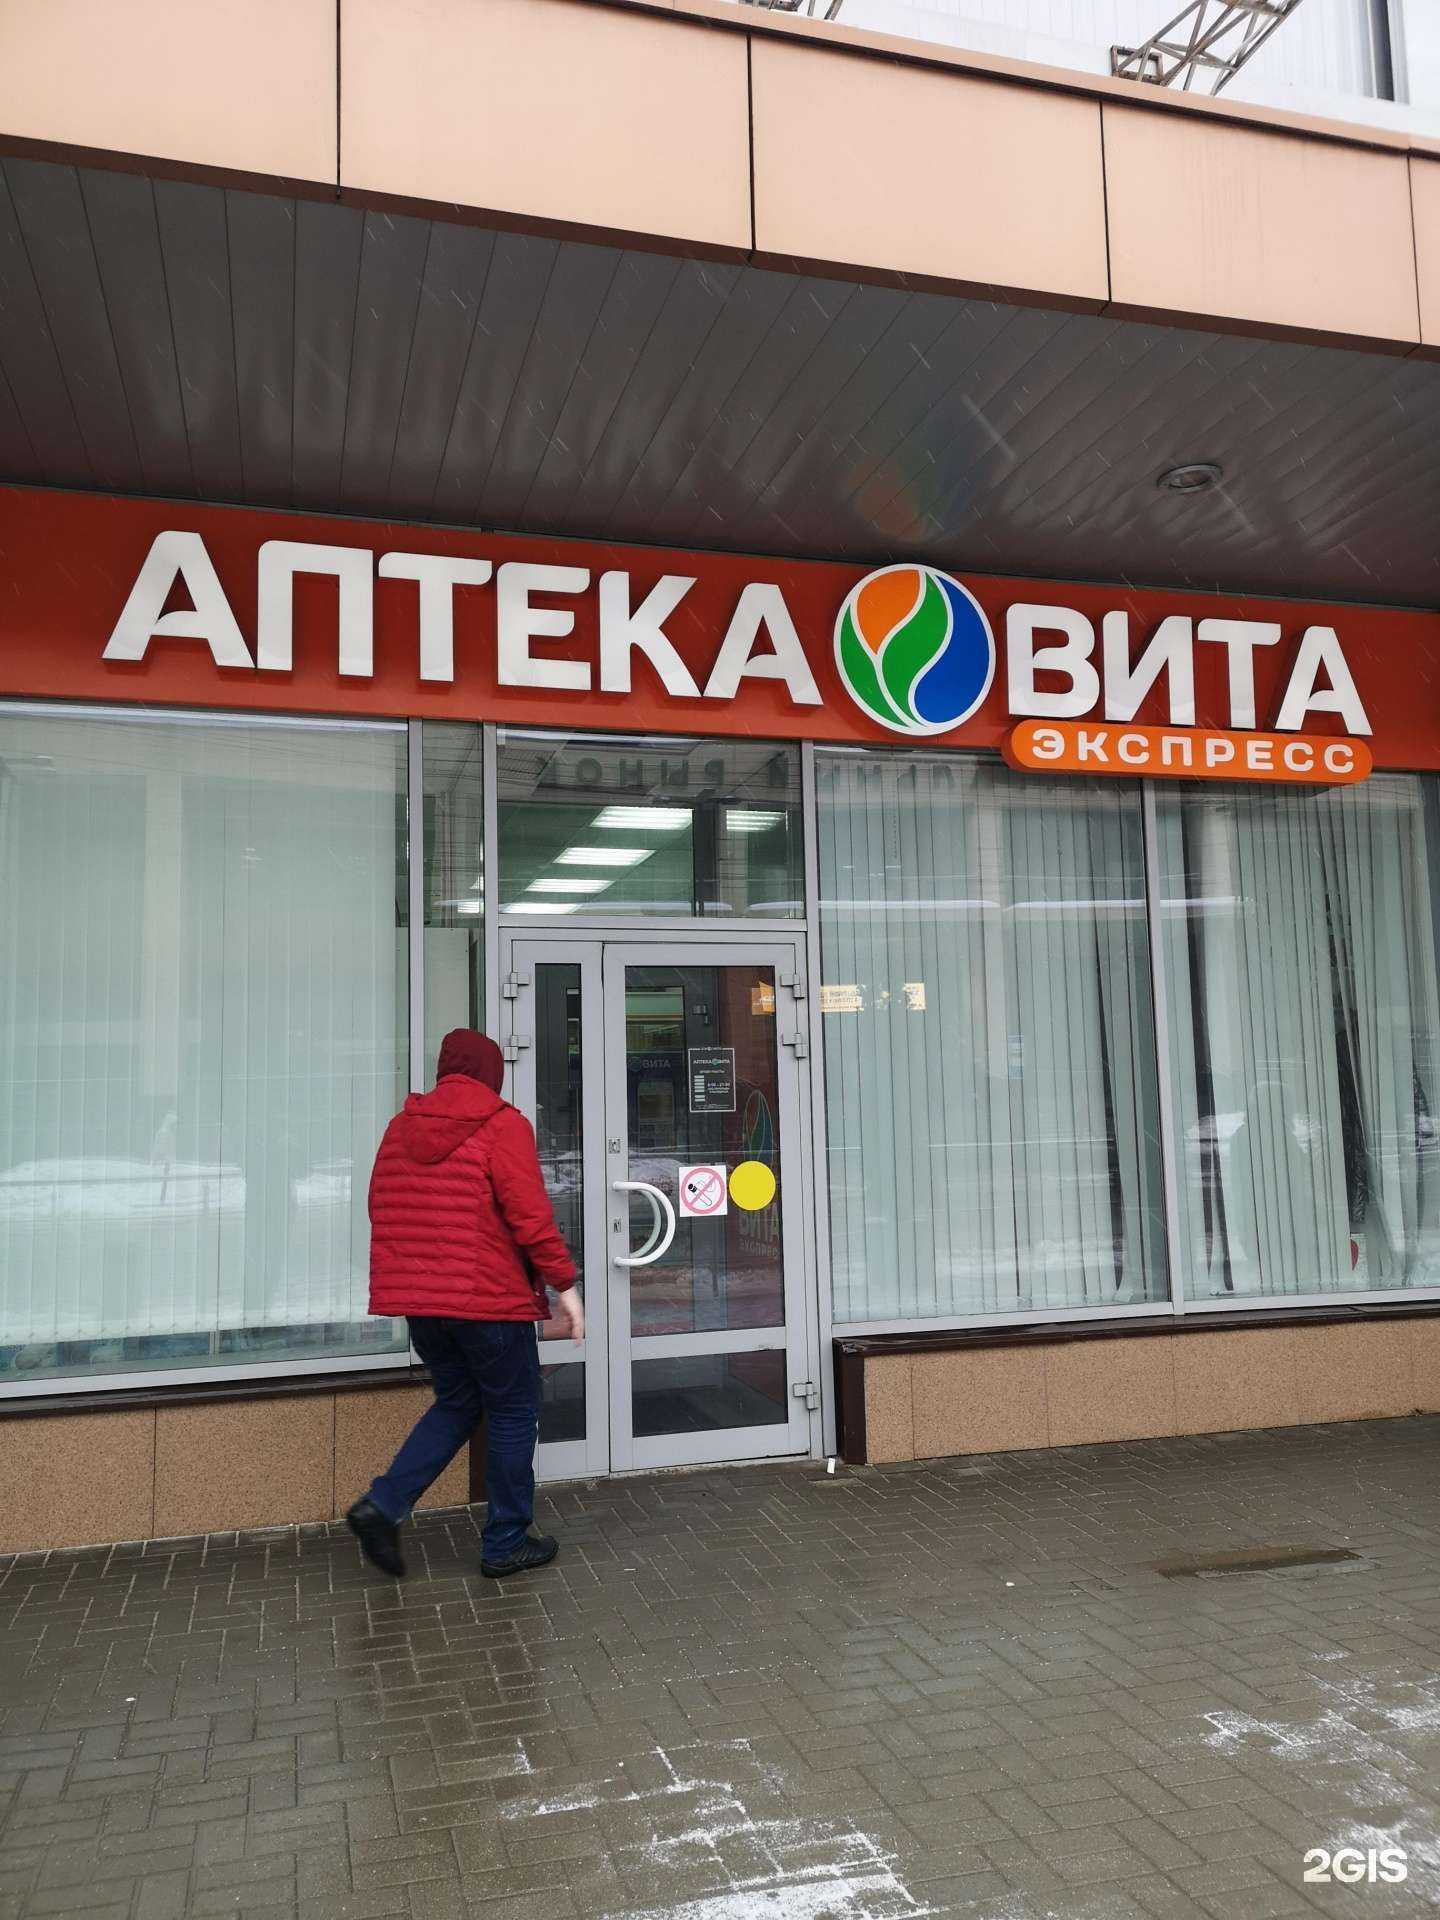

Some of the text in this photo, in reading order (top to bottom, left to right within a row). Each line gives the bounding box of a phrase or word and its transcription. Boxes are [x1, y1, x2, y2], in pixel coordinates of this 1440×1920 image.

[102, 530, 1373, 736] АПТЕКА ВИТА
[1032, 728, 1354, 773] ЭКСПРЕСС
[642, 1059, 671, 1069] ВИТА
